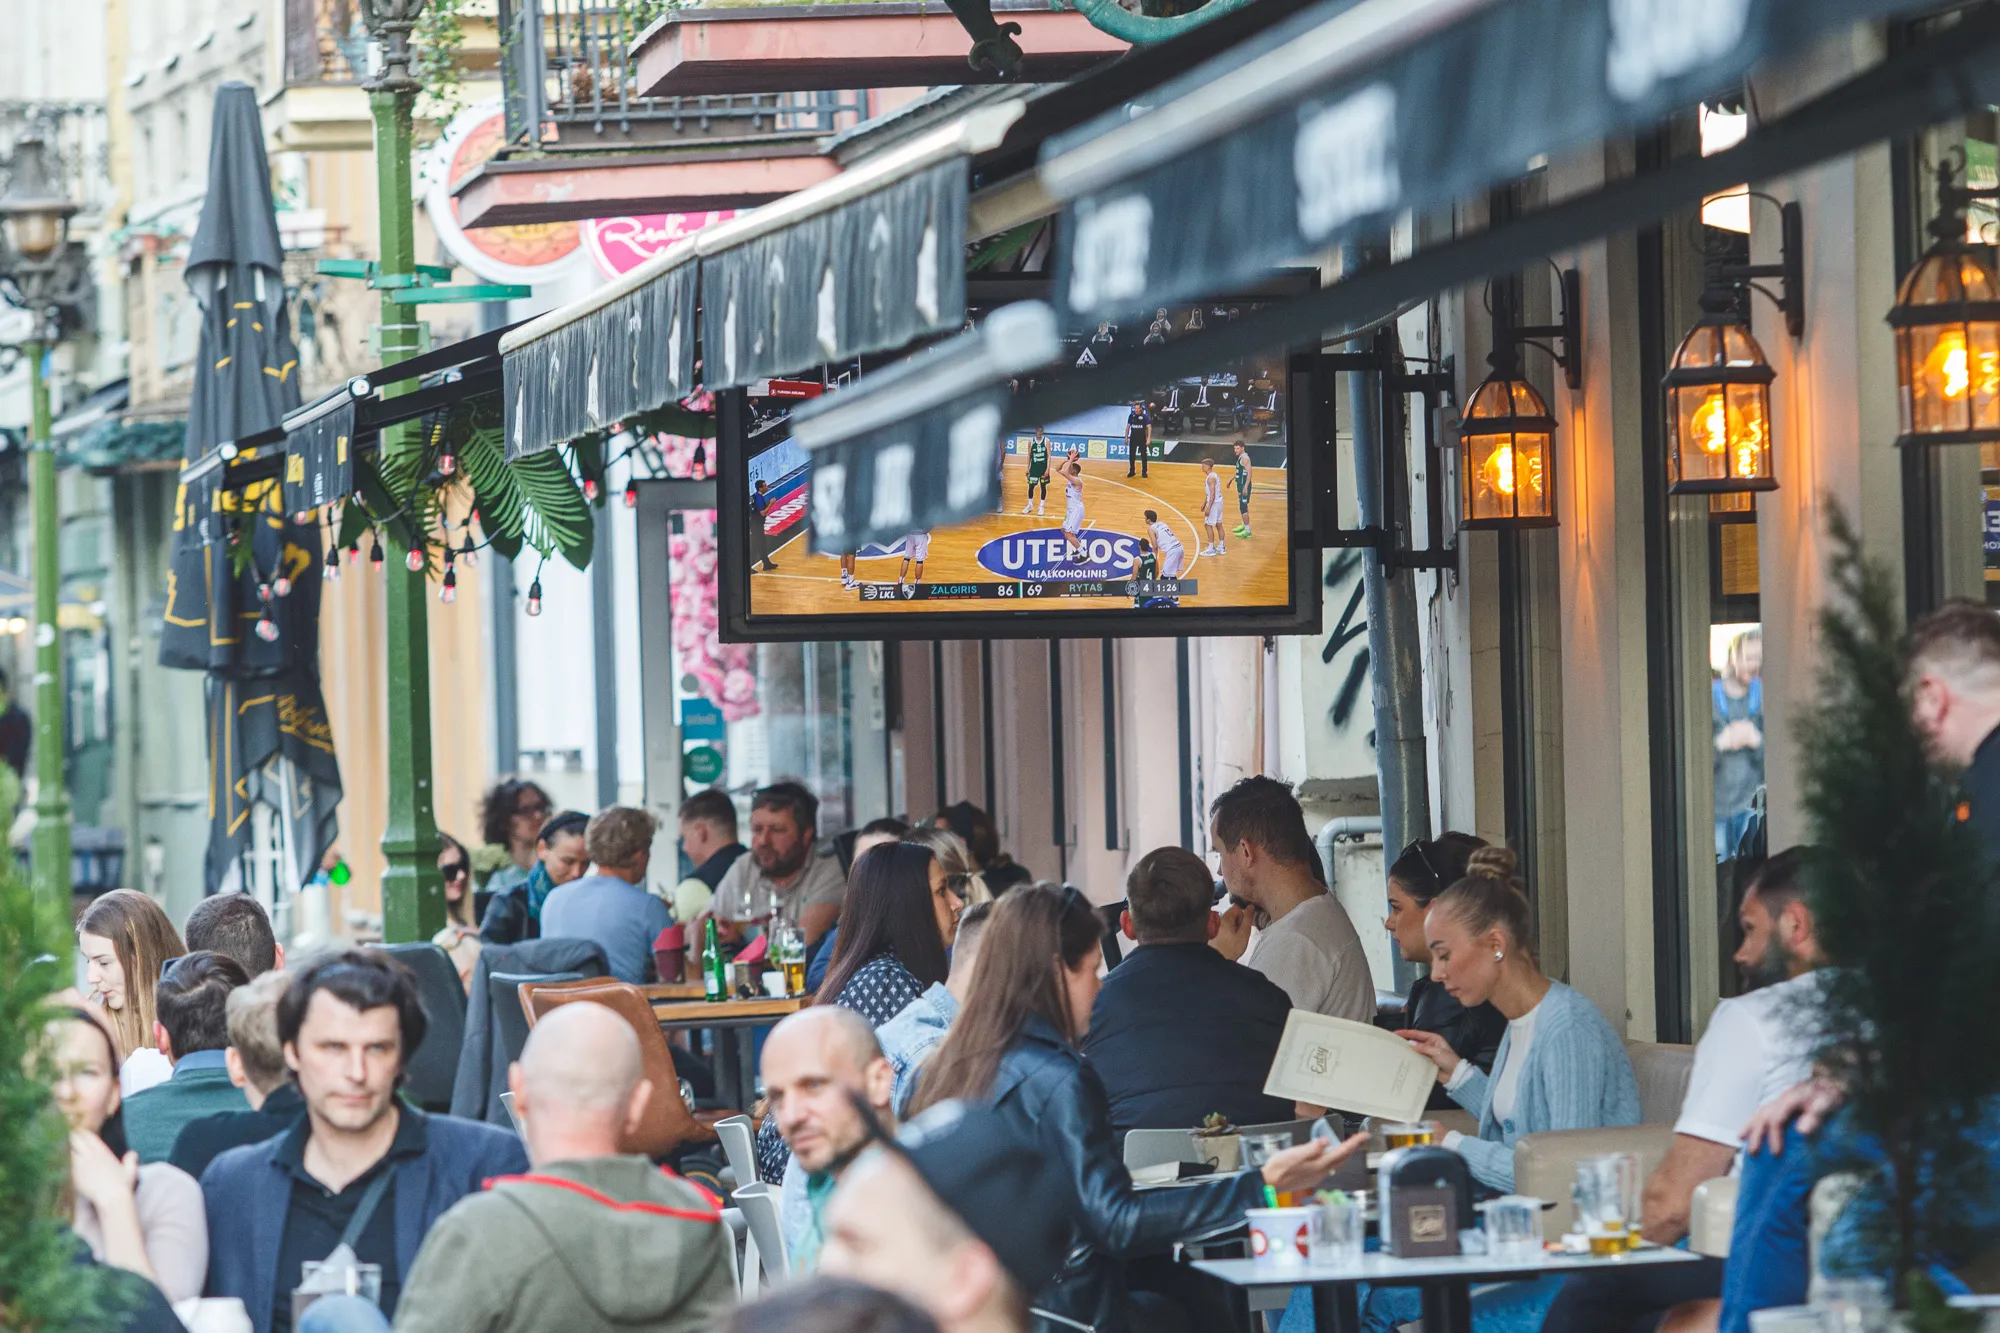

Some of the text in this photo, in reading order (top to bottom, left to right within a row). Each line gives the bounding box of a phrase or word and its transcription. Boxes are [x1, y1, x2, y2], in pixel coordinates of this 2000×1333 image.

[1027, 569, 1108, 579] NEALKOHOLINIS
[879, 590, 896, 599] LKL
[931, 583, 1177, 597] ŽALGIRIS 86 69 RYTAS 4 1:26
